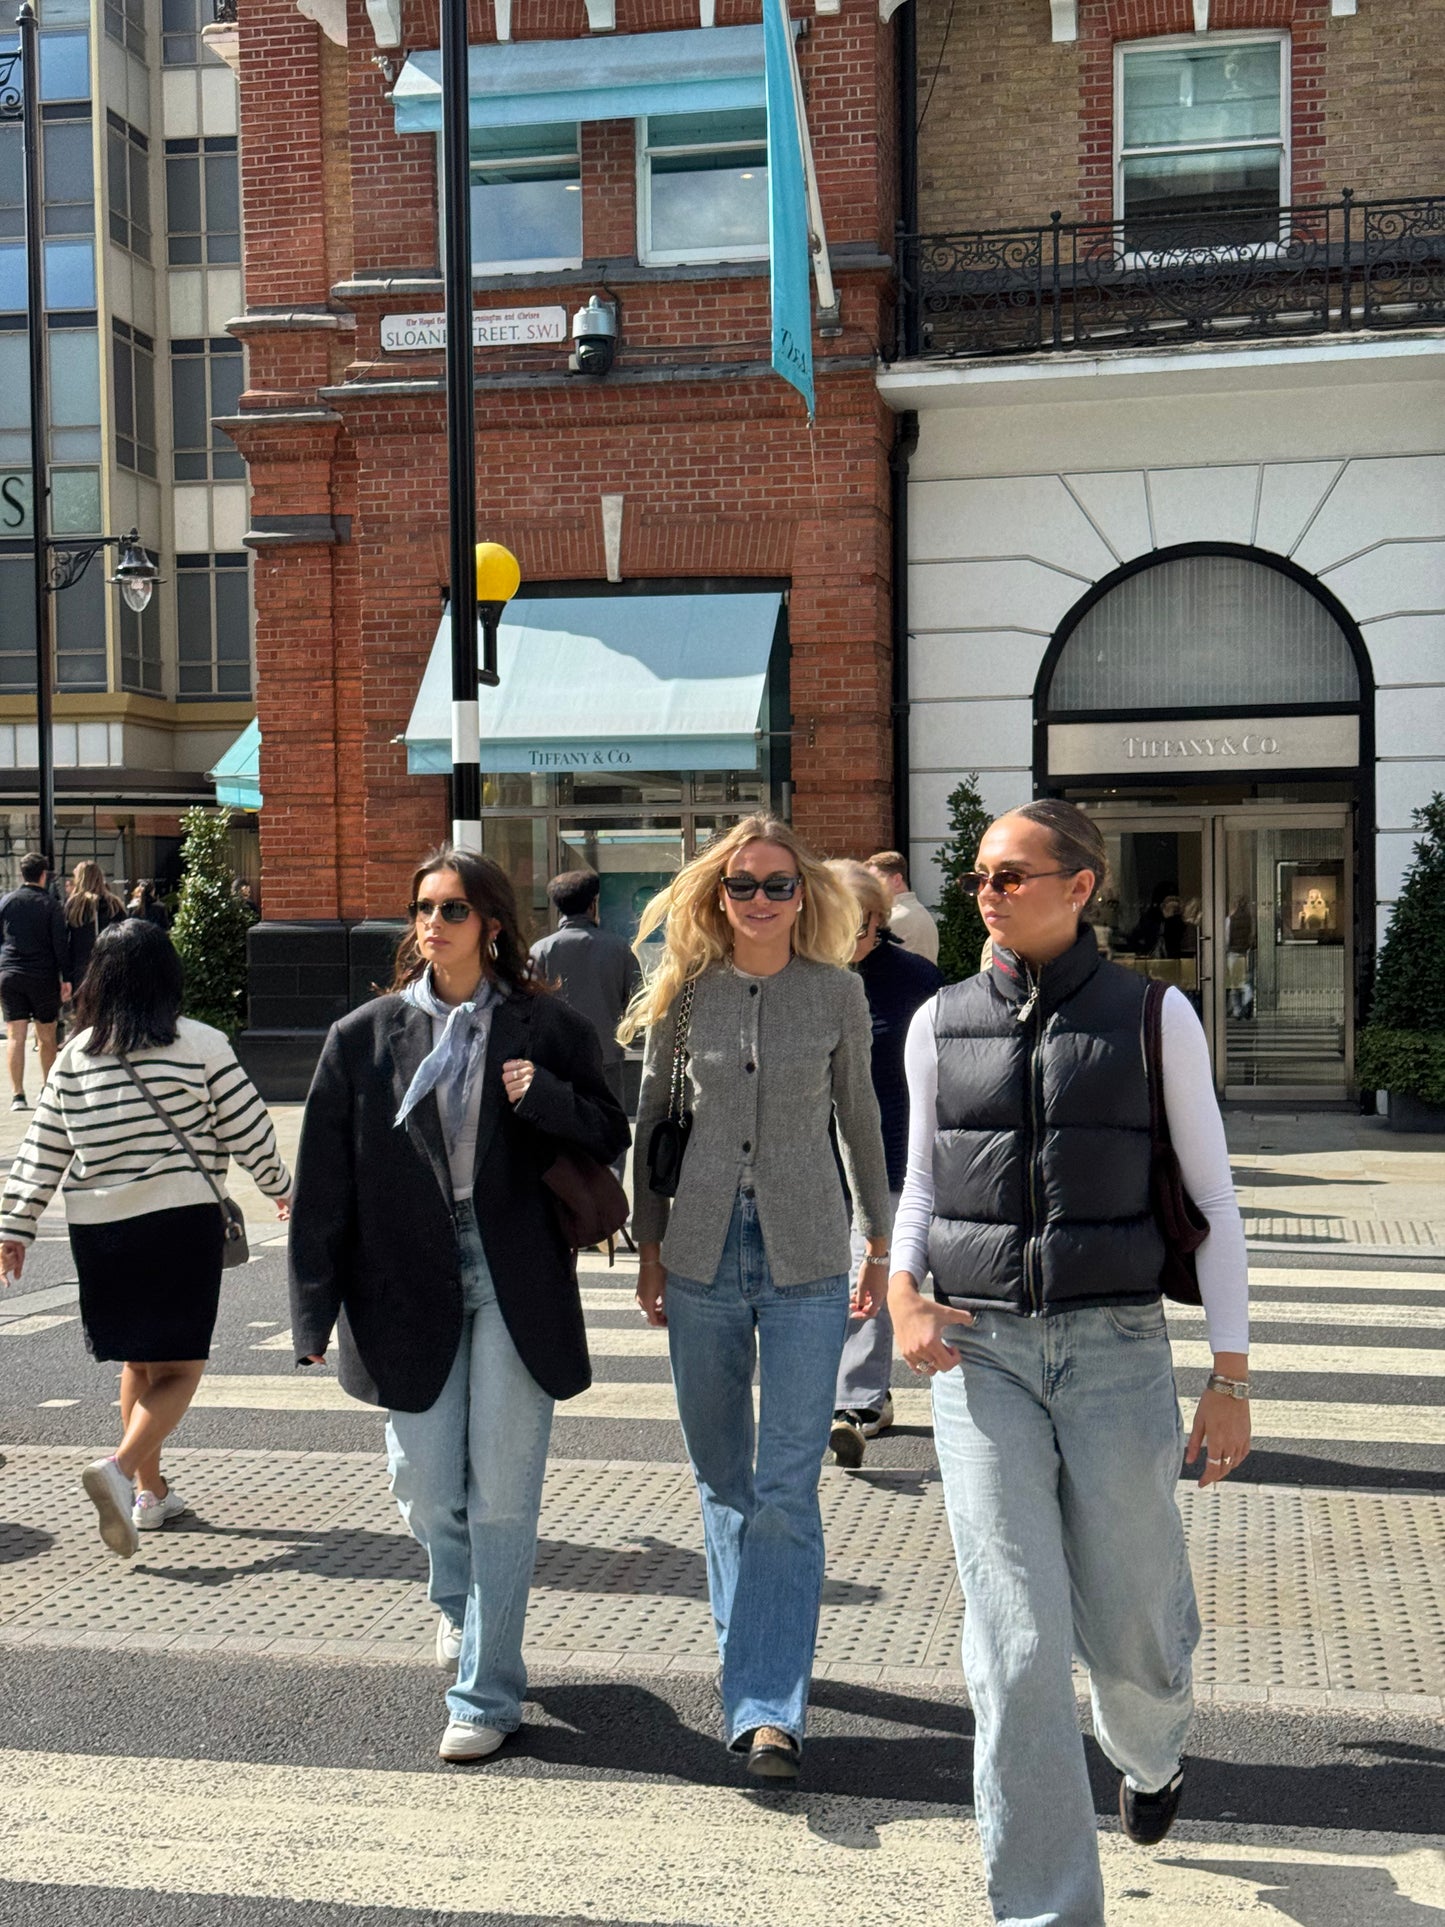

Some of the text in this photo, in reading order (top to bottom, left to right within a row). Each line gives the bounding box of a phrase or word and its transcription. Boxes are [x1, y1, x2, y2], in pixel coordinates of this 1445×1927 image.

[473, 325, 520, 343] REET.
[527, 323, 559, 340] S.W.1
[1122, 736, 1217, 758] TIFFANY
[1220, 736, 1239, 756] &
[528, 750, 589, 766] TIFFANY
[592, 750, 604, 765] &
